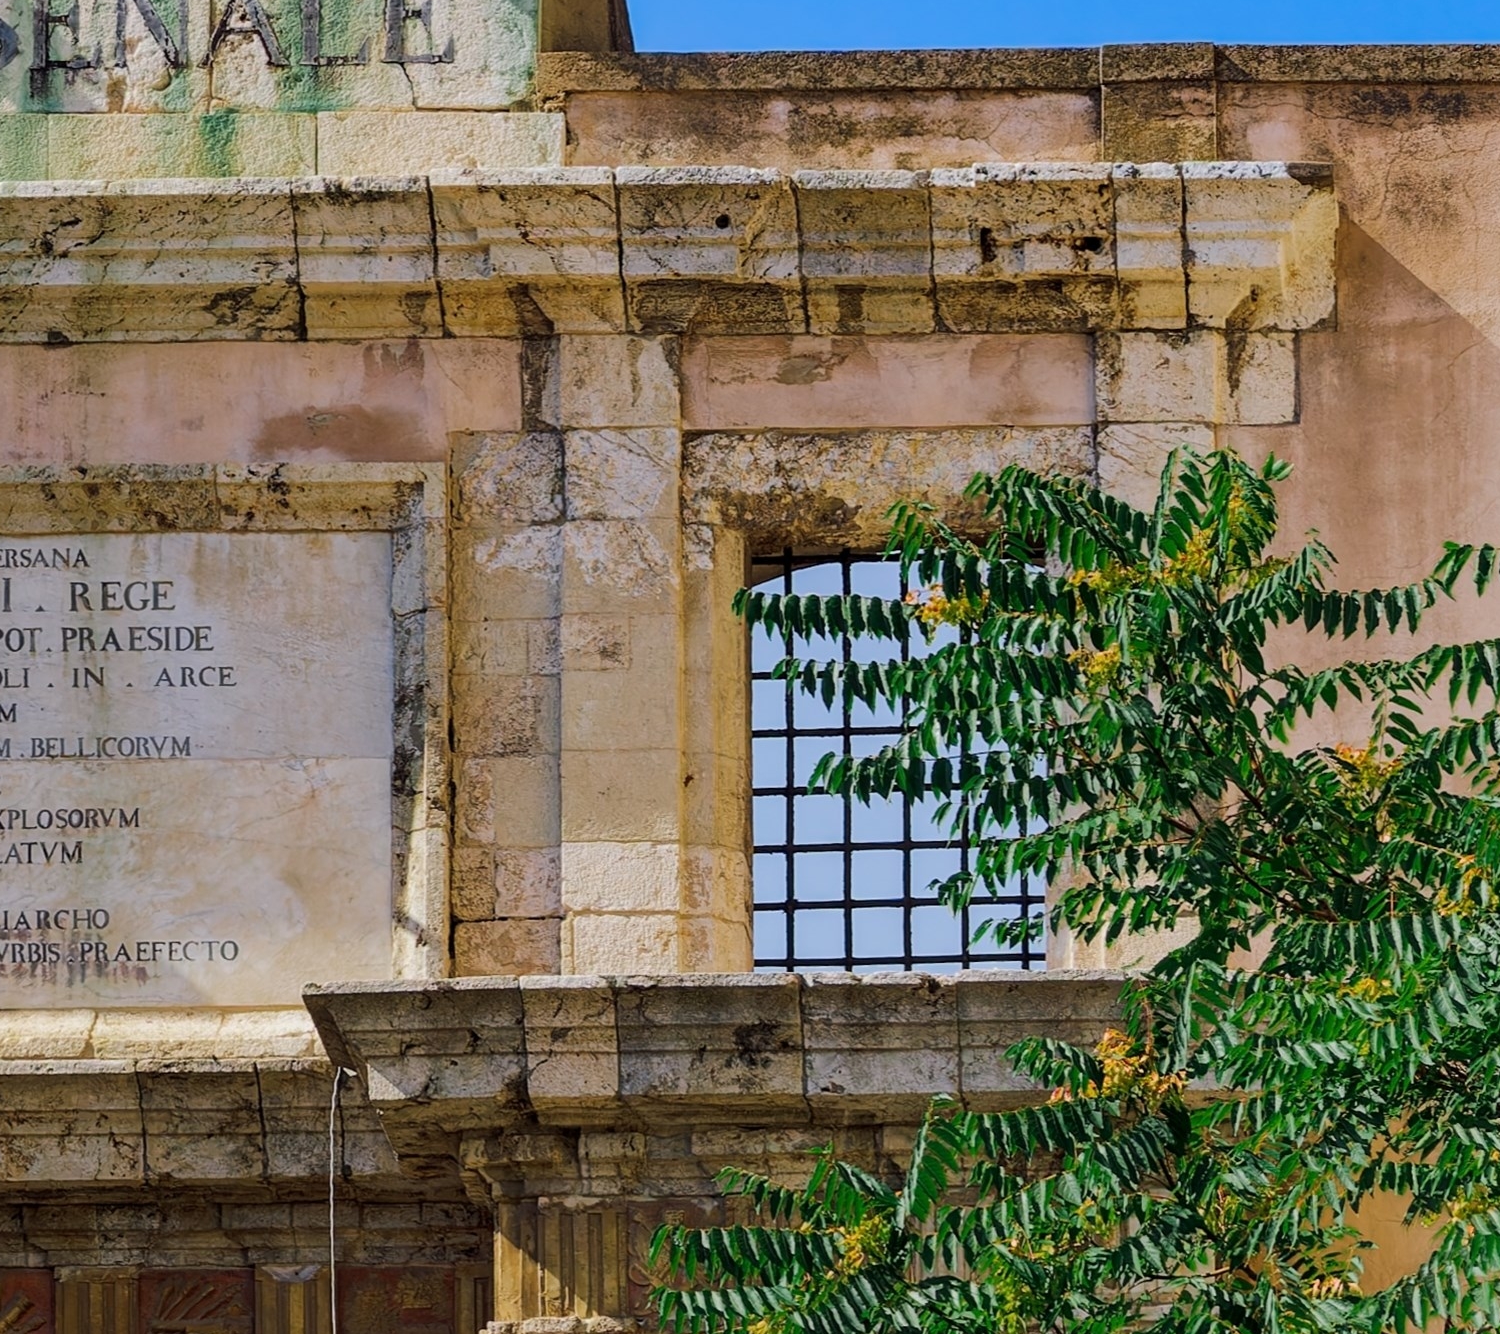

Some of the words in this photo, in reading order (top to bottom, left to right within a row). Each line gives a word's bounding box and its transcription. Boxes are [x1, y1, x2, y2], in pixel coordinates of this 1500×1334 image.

[69, 580, 176, 612] REGE
[61, 625, 215, 652] PRAESIDE
[155, 667, 238, 687] ARCE
[31, 736, 192, 759] BELLICORVM
[79, 939, 239, 963] PRAEFECTO
